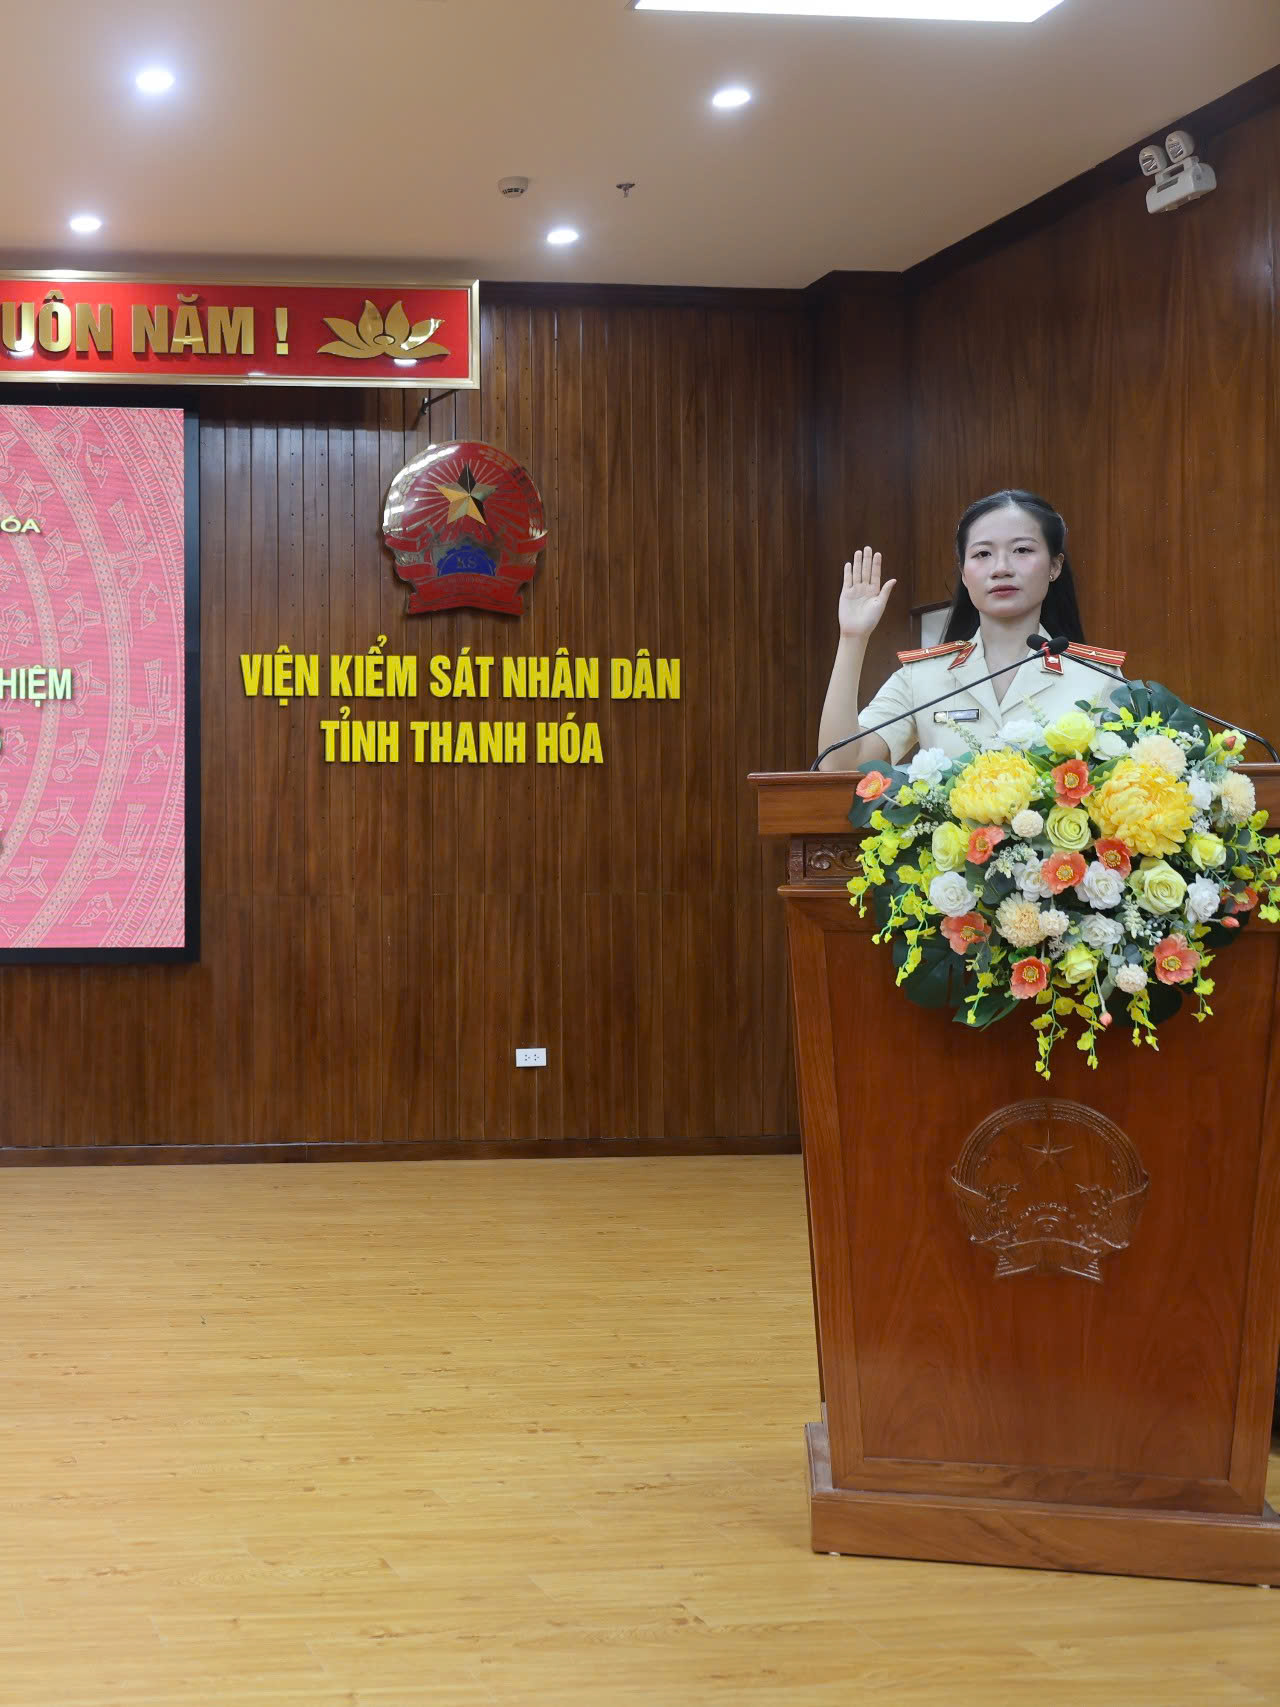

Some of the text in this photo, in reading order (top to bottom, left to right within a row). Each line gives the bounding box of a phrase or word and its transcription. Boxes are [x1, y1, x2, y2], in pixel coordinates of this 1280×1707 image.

[132, 292, 254, 355] NĂM
[275, 306, 290, 355] !
[240, 635, 681, 706] VIỆN KIỂM SÁT NHÂN DÂN
[320, 706, 604, 764] TỈNH THANH HÓA
